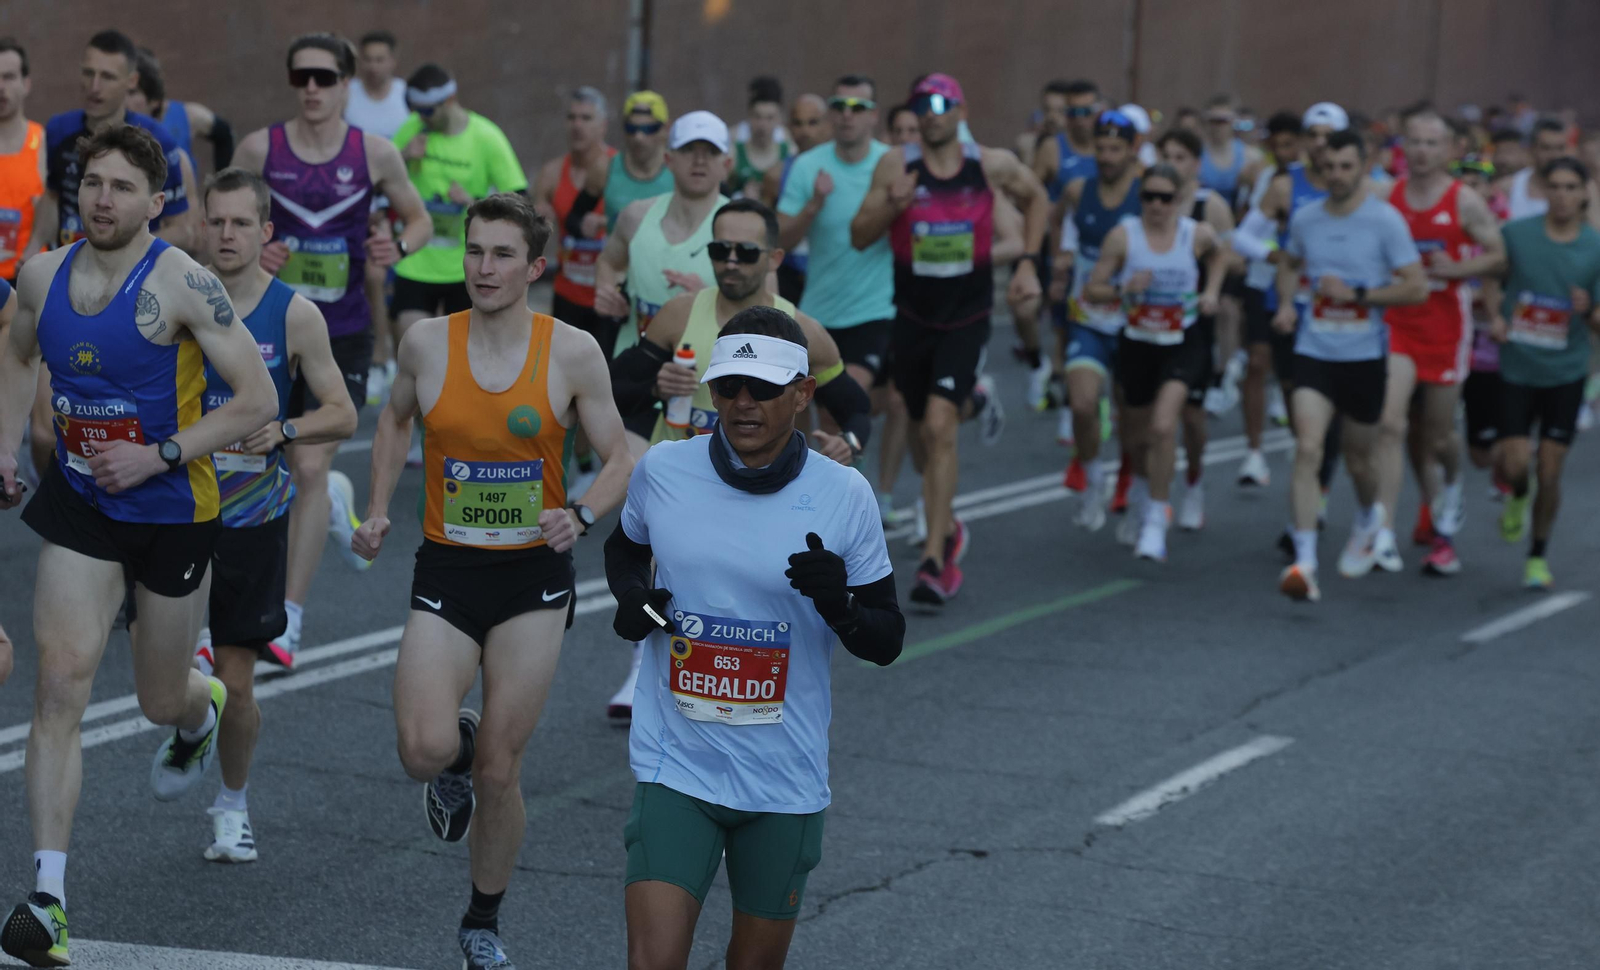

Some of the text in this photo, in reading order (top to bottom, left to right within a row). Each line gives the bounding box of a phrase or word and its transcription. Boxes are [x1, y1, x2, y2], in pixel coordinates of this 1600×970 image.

[75, 404, 124, 416] ZURICH
[81, 427, 107, 439] 1219
[477, 467, 530, 479] ZURICH
[479, 492, 507, 503] 1497
[462, 507, 522, 525] SPOOR
[711, 624, 775, 642] ZURICH
[714, 655, 740, 670] 653
[678, 670, 776, 700] GERALDO
